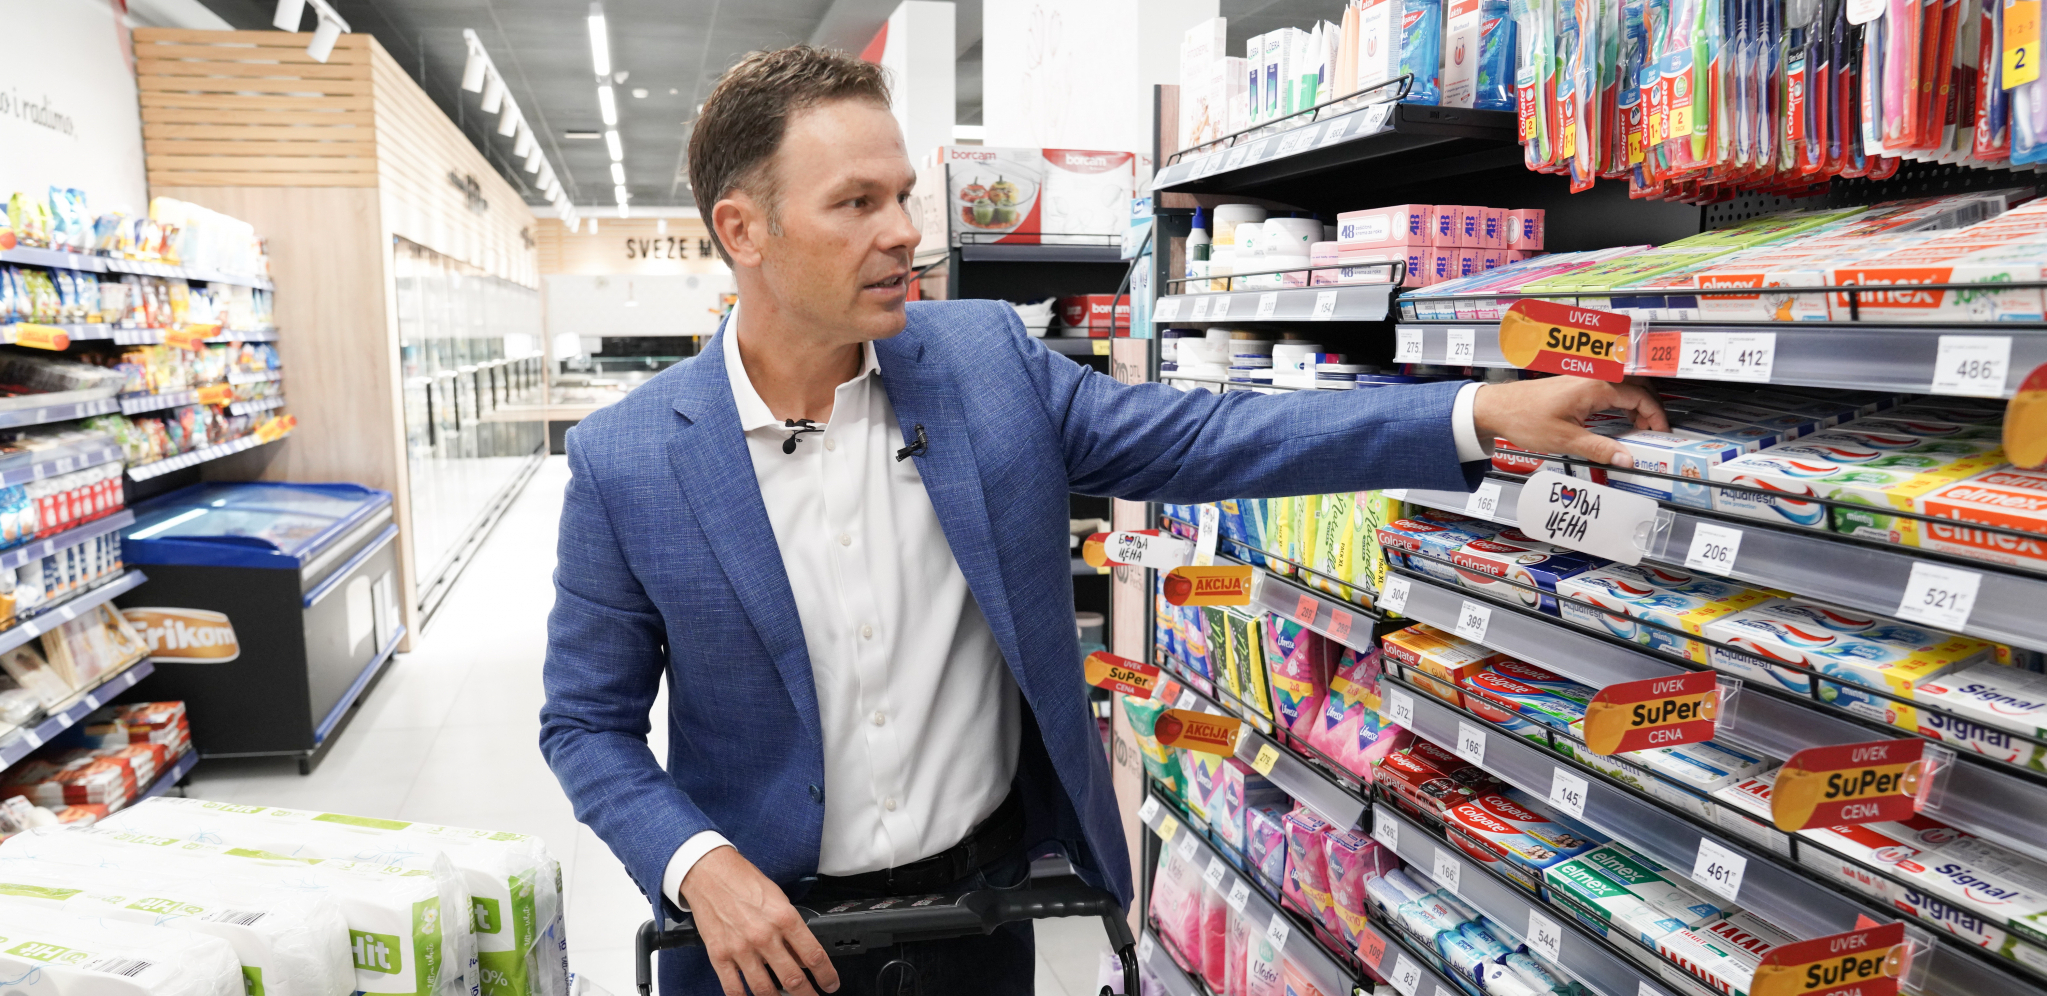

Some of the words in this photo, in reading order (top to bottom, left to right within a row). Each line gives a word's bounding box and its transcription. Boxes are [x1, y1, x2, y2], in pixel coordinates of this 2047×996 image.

[1451, 6, 1463, 17] aktiv
[2014, 48, 2025, 70] 2
[1661, 79, 1669, 138] Colgate
[1787, 77, 1795, 134] Colgate
[1528, 120, 1533, 130] 2
[1678, 112, 1683, 124] 2
[951, 149, 997, 161] borcam
[1066, 154, 1106, 167] borcam
[1341, 224, 1355, 239] 48
[1410, 214, 1420, 236] 48
[1440, 215, 1450, 237] 48
[1465, 216, 1475, 237] 48
[1487, 217, 1496, 238] 48
[1524, 218, 1533, 240] 48
[1409, 255, 1419, 277] 48
[1436, 256, 1446, 278] 48
[1701, 277, 1757, 300] elmex
[1842, 272, 1938, 305] elmex
[1569, 310, 1601, 327] UVEK
[1407, 341, 1419, 353] 275
[1455, 343, 1469, 355] 275
[1546, 328, 1615, 358] SuPer
[1651, 346, 1672, 361] 228
[1692, 349, 1715, 366] 224
[1738, 350, 1763, 367] 412
[1561, 358, 1594, 374] CENA
[1956, 360, 1993, 380] 486
[1492, 444, 1538, 465] olgate
[1477, 496, 1493, 511] 166
[1945, 485, 2047, 511] elmex
[1395, 519, 1433, 531] Colgate
[1545, 510, 1588, 542] ЦЕНА
[1846, 511, 1875, 528] minty
[1379, 532, 1413, 551] Colgate
[1932, 509, 2044, 556] elmex
[1118, 547, 1143, 562] ЦЕНА
[1702, 543, 1728, 561] 206
[1454, 555, 1499, 575] Colgate
[1195, 576, 1242, 592] AKCIJA
[1391, 588, 1405, 601] 304
[1923, 587, 1957, 611] 521
[1466, 614, 1482, 630] 399
[1652, 630, 1674, 646] minty
[1384, 641, 1416, 664] Colgate
[1123, 659, 1143, 672] UVEK
[1499, 661, 1551, 681] Colgate
[1108, 667, 1149, 687] SuPer
[1478, 672, 1530, 694] Colgate
[1653, 679, 1685, 695] UVEK
[1115, 682, 1136, 695] CENA
[1959, 683, 2047, 712] Signal
[1397, 704, 1410, 720] 372
[1631, 700, 1703, 727] SuPer
[1184, 722, 1230, 741] AKCIJA
[1648, 728, 1683, 744] CENA
[1927, 705, 2011, 750] Signal
[1464, 737, 1480, 756] 166
[1852, 745, 1889, 763] UVEK
[1390, 753, 1424, 772] Colgate
[1372, 767, 1406, 793] Colgate
[1824, 771, 1905, 799] SuPer
[1561, 786, 1579, 807] 145
[1485, 794, 1534, 822] Colgate
[1840, 803, 1880, 820] CENA
[1458, 805, 1506, 833] Colgate
[1441, 863, 1456, 882] 166
[1592, 851, 1645, 883] elmex
[1706, 861, 1731, 886] 461
[1561, 864, 1614, 897] elmex
[1935, 863, 2020, 901] Signal
[1904, 889, 1984, 936] Signal
[1272, 928, 1283, 943] 344
[1538, 929, 1556, 951] 544
[1830, 933, 1869, 954] UVEK
[351, 934, 391, 970] Hit
[1369, 943, 1381, 959] 109
[1403, 971, 1414, 987] 83
[1804, 955, 1887, 989] SuPer
